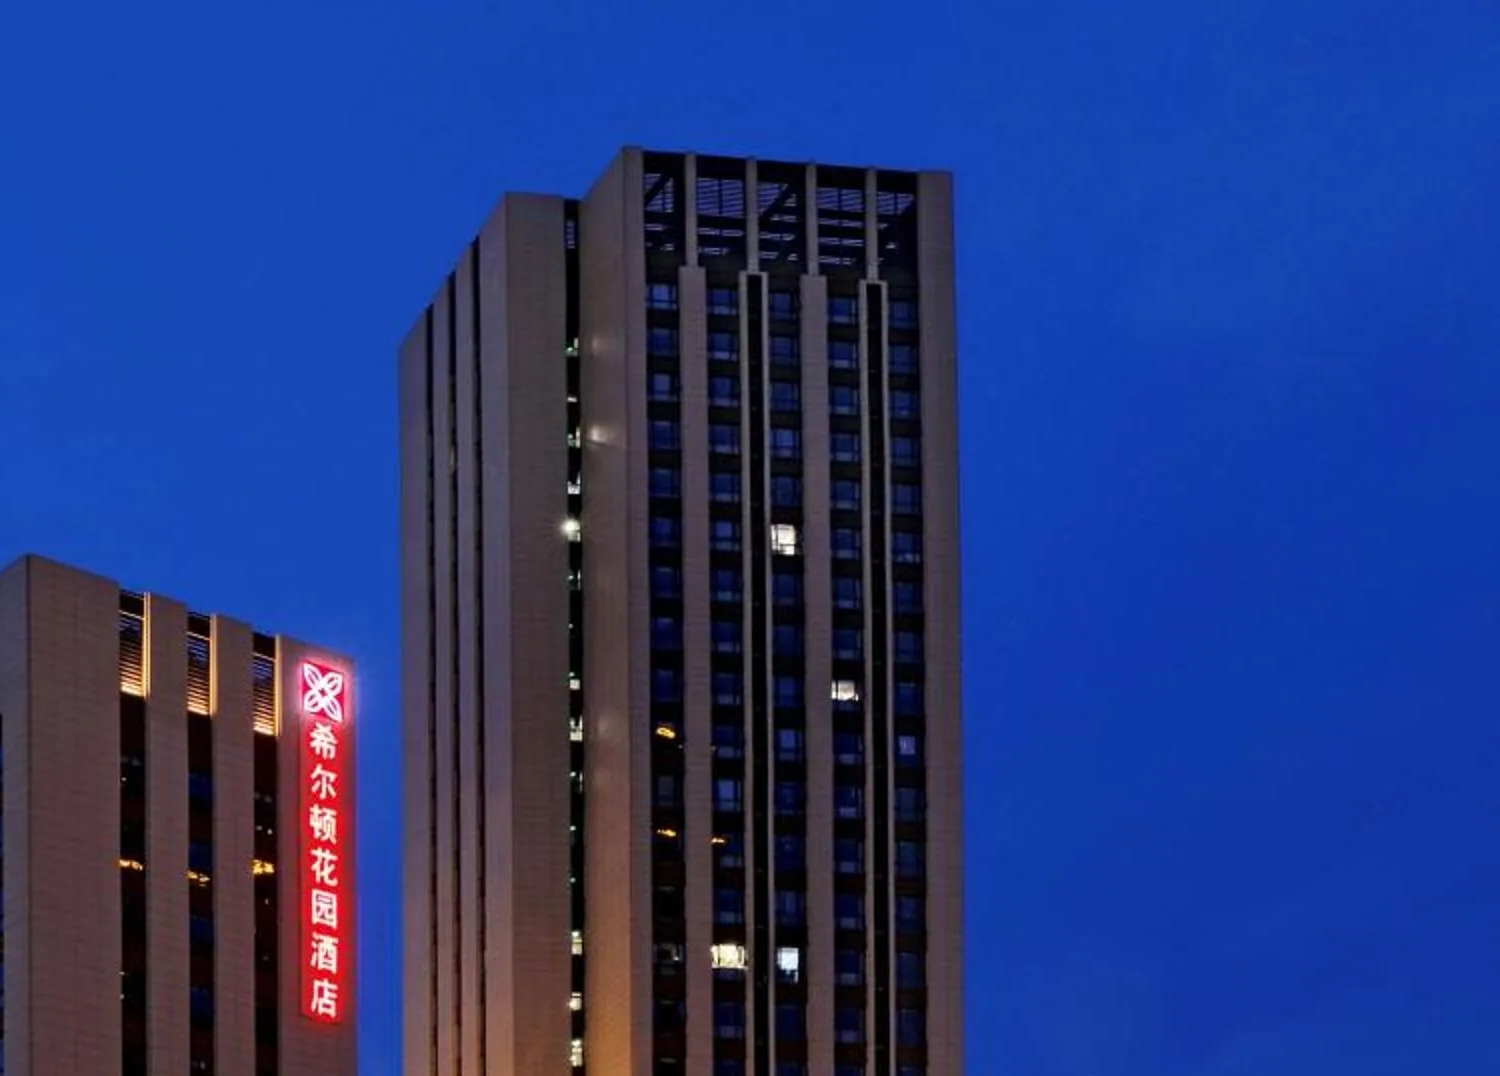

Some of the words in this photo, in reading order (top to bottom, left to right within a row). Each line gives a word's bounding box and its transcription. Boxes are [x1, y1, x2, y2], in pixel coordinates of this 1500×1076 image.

[308, 721, 339, 1018] 希尔顿花园酒店
